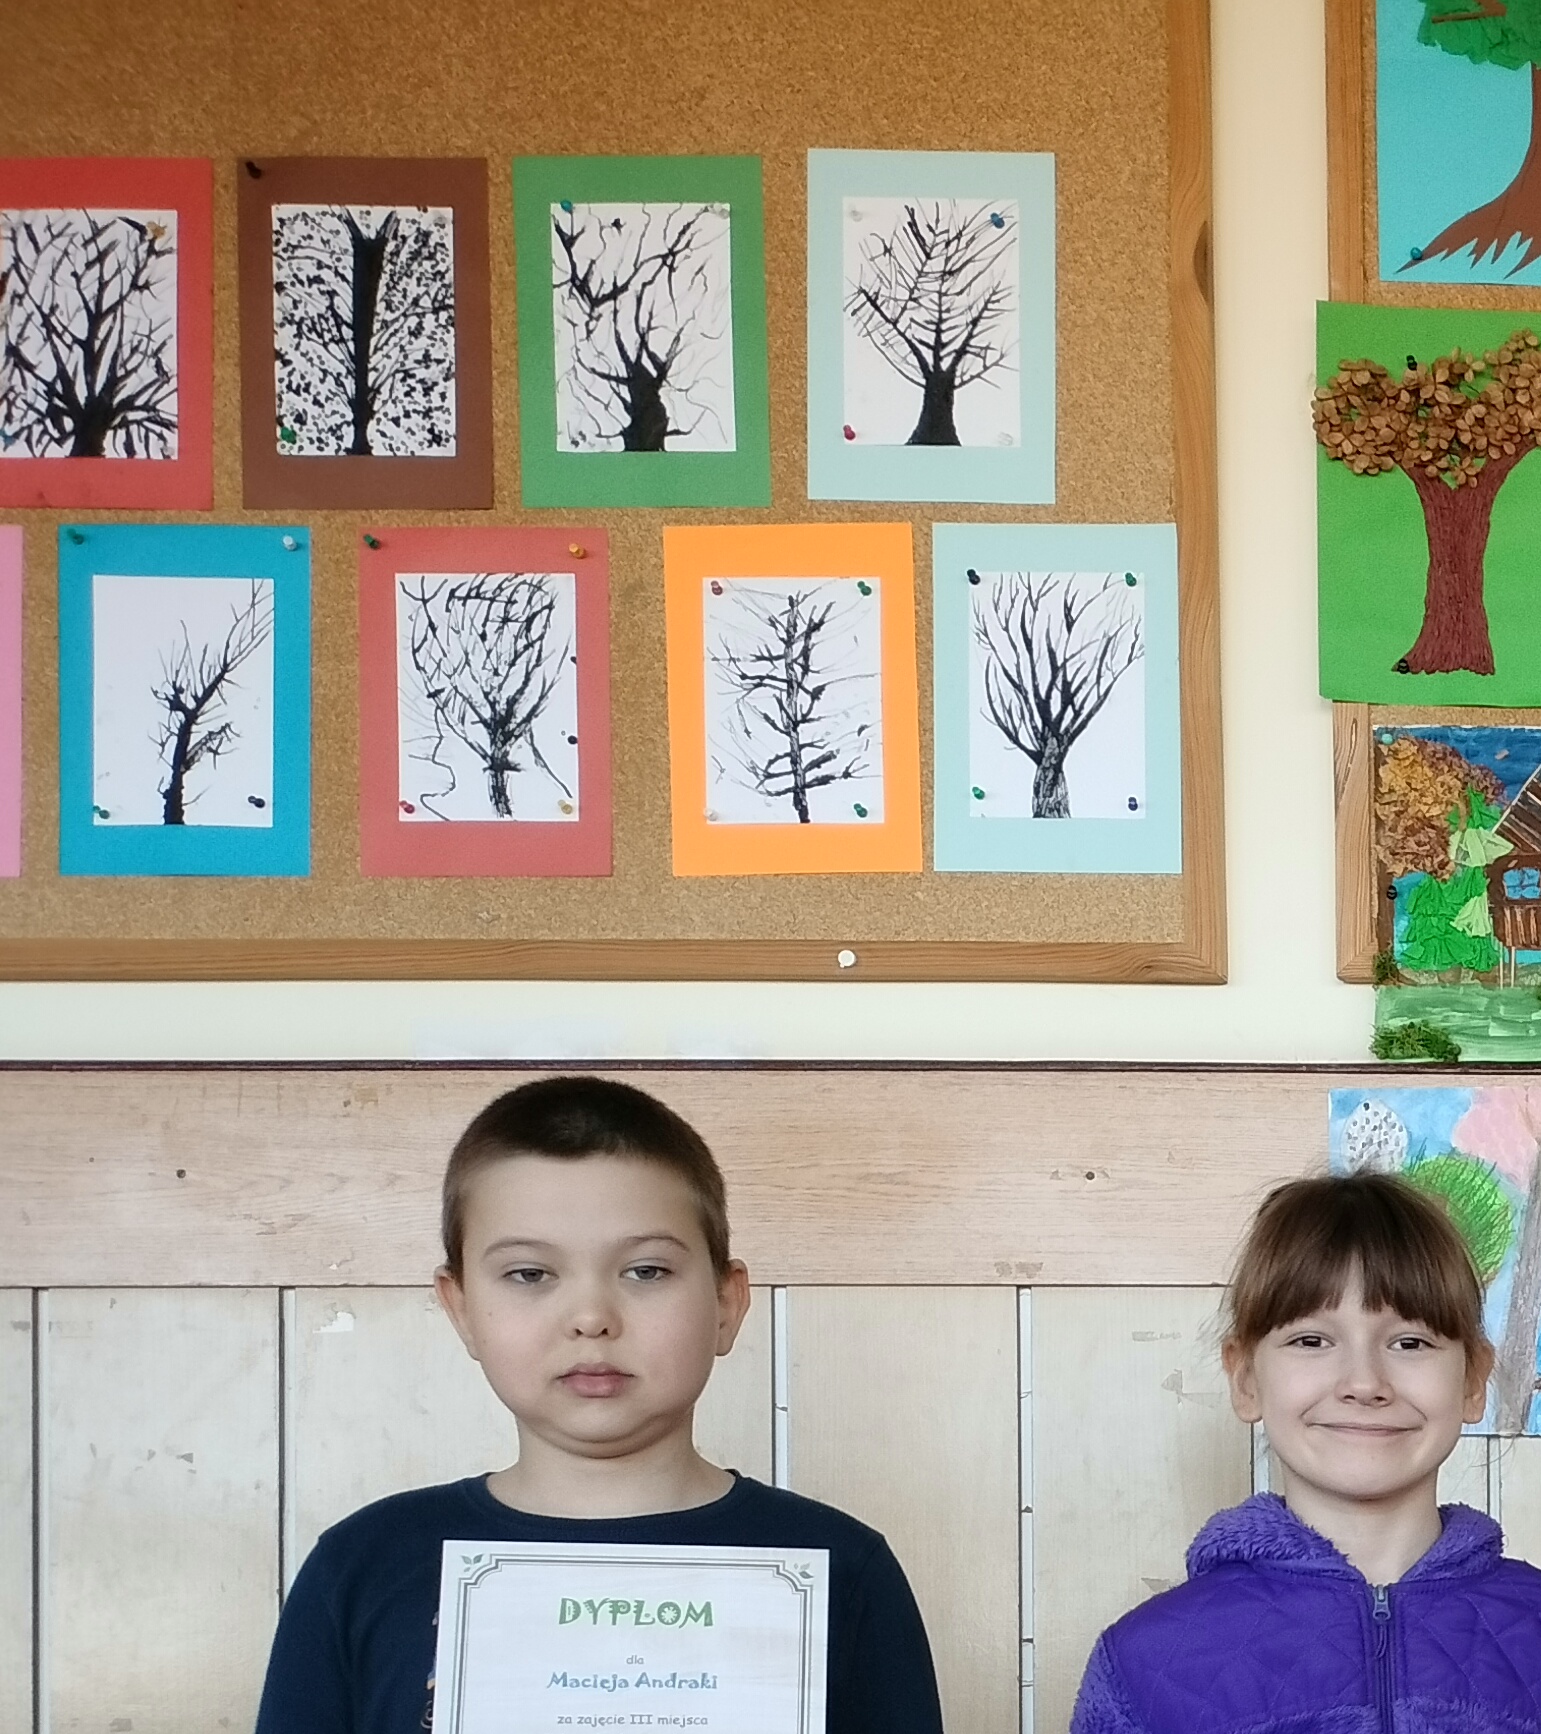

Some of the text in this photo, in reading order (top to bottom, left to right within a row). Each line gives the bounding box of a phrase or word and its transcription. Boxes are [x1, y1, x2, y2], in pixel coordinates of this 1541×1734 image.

[559, 1598, 713, 1628] DYPLOM
[626, 1655, 644, 1665] dla
[547, 1672, 717, 1692] Macieja Andraki
[557, 1714, 708, 1727] za zajęcie III miejsca
